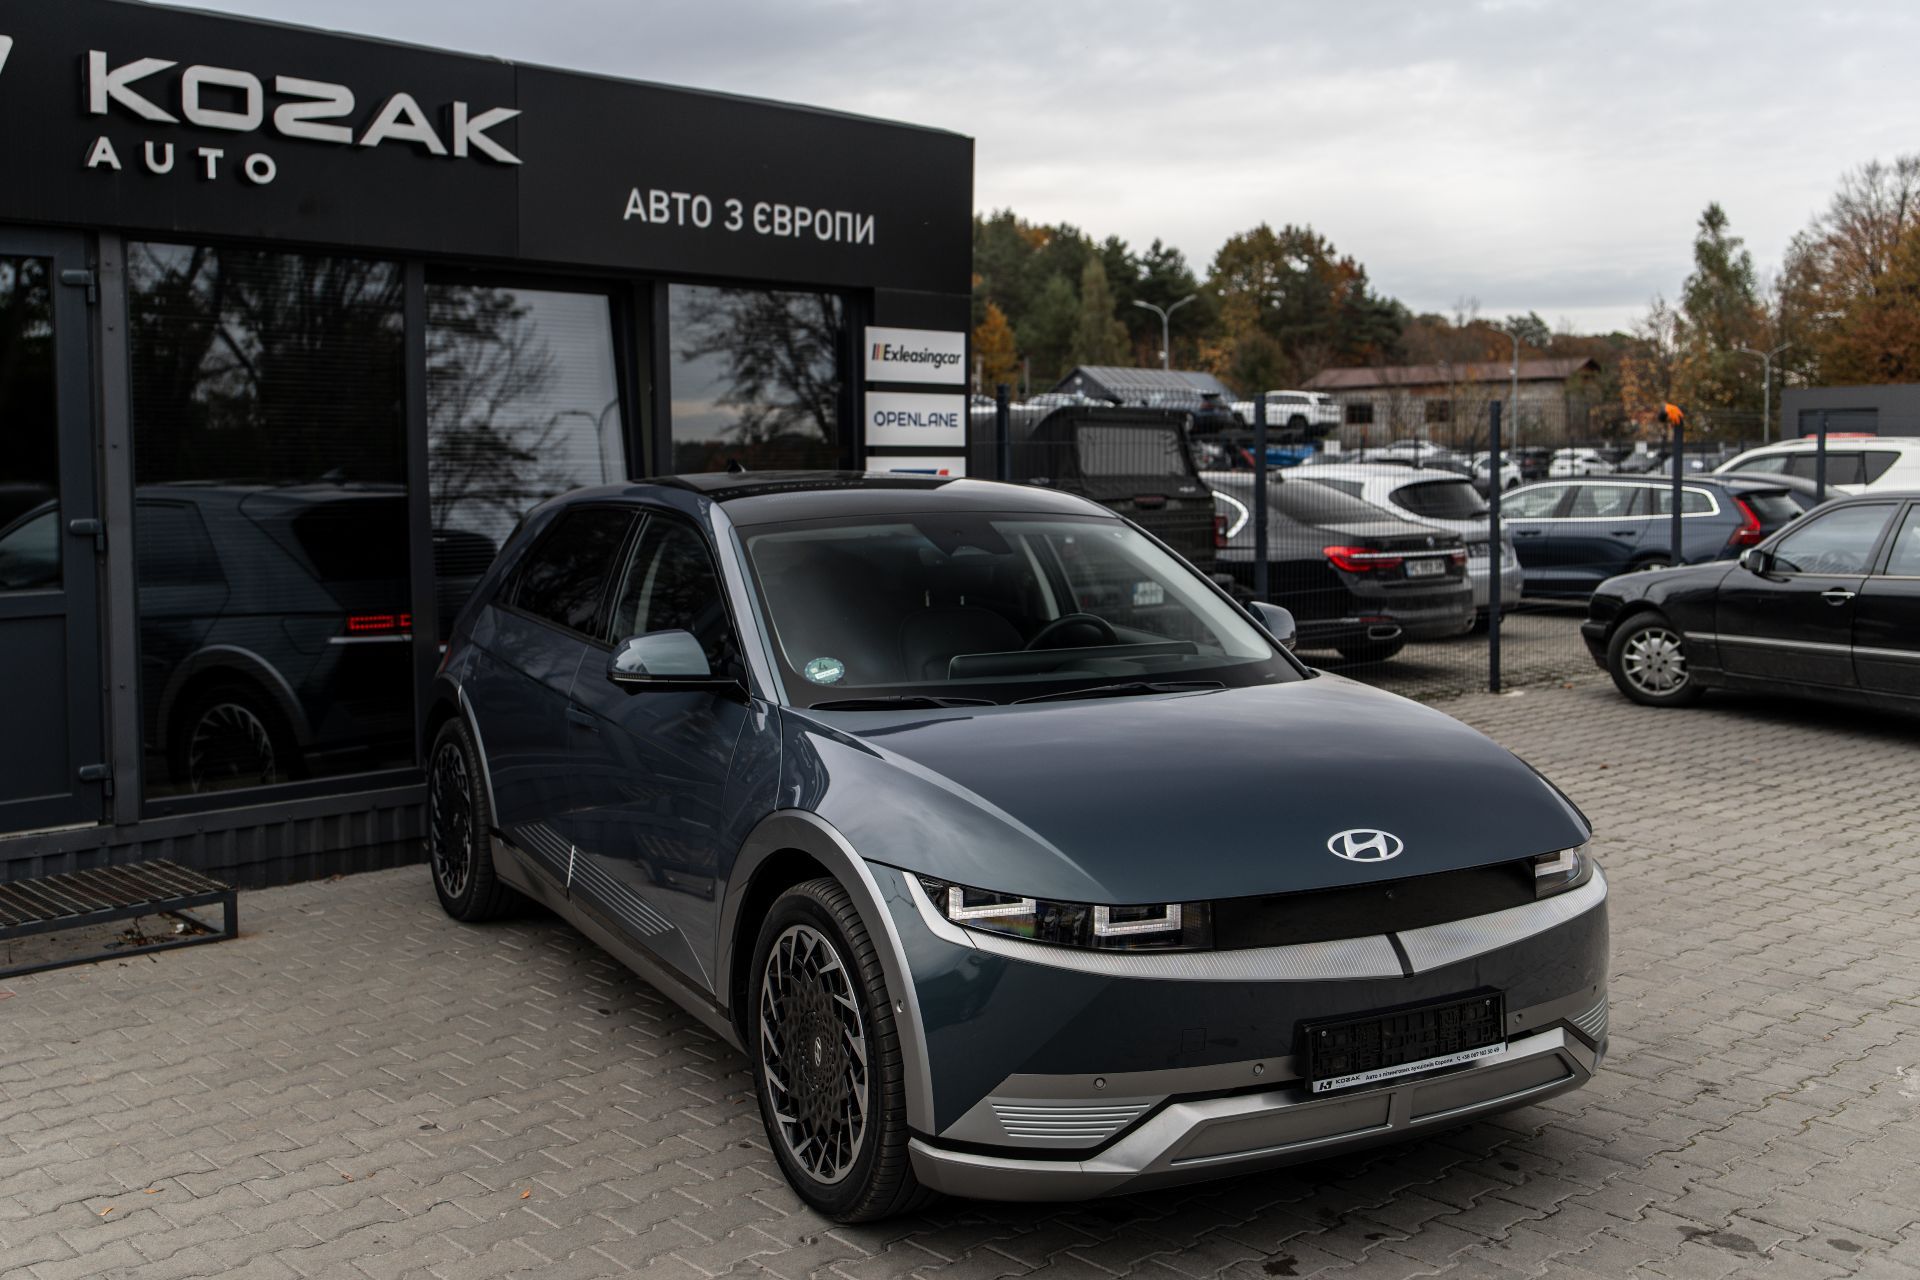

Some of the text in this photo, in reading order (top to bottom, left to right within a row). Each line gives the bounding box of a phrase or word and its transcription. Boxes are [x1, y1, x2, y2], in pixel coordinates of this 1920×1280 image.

[86, 49, 524, 165] KOZAK
[86, 135, 278, 185] AUTO
[623, 187, 876, 246] АВТО З ЄВРОПИ
[883, 343, 962, 369] Exleasingcar
[873, 410, 959, 428] OPENLANE
[1335, 1074, 1361, 1084] KOZAK
